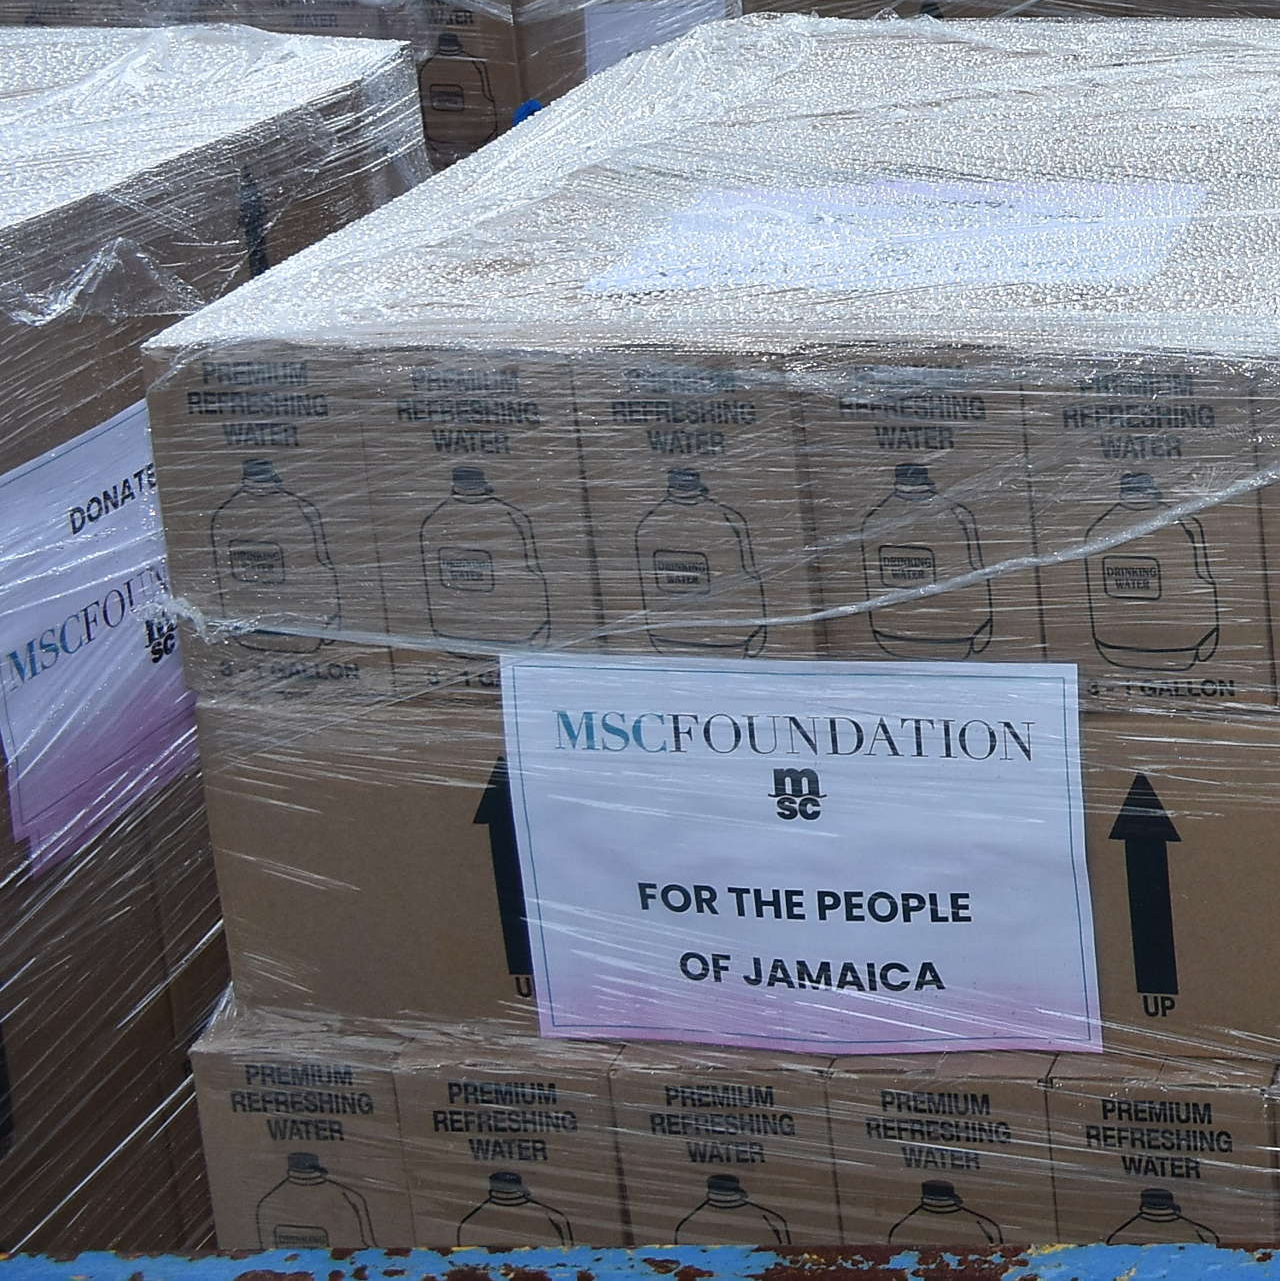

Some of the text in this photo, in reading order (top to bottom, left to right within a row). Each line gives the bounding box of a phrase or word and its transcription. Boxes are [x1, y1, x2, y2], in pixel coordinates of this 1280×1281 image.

[874, 425, 956, 450] WATER
[1101, 434, 1183, 460] WATER
[67, 462, 158, 536] DONATE
[1106, 566, 1158, 579] DRINKING
[1114, 577, 1151, 591] WATER
[551, 708, 1035, 764] MSCFOUNDATION
[637, 880, 972, 925] FOR THE PEOPLE
[679, 950, 947, 993] OF JAMAICA
[1142, 994, 1177, 1019] UP
[244, 1063, 354, 1087] PREMIUM
[230, 1091, 374, 1116] REFRESHING
[447, 1081, 558, 1106] PREMIUM
[664, 1084, 775, 1109] PREMIUM
[880, 1090, 992, 1116] PREMIUM
[431, 1110, 578, 1134] REFRESHING
[650, 1113, 797, 1137] REFRESHING
[1100, 1099, 1213, 1126] PREMIUM
[266, 1119, 345, 1143] WATER
[864, 1118, 1012, 1144] REFRESHING
[1085, 1127, 1233, 1154] REFRESHING
[468, 1137, 549, 1162] WATER
[685, 1141, 766, 1165] WATER
[900, 1145, 981, 1171] WATER
[1121, 1154, 1201, 1179] WATER
